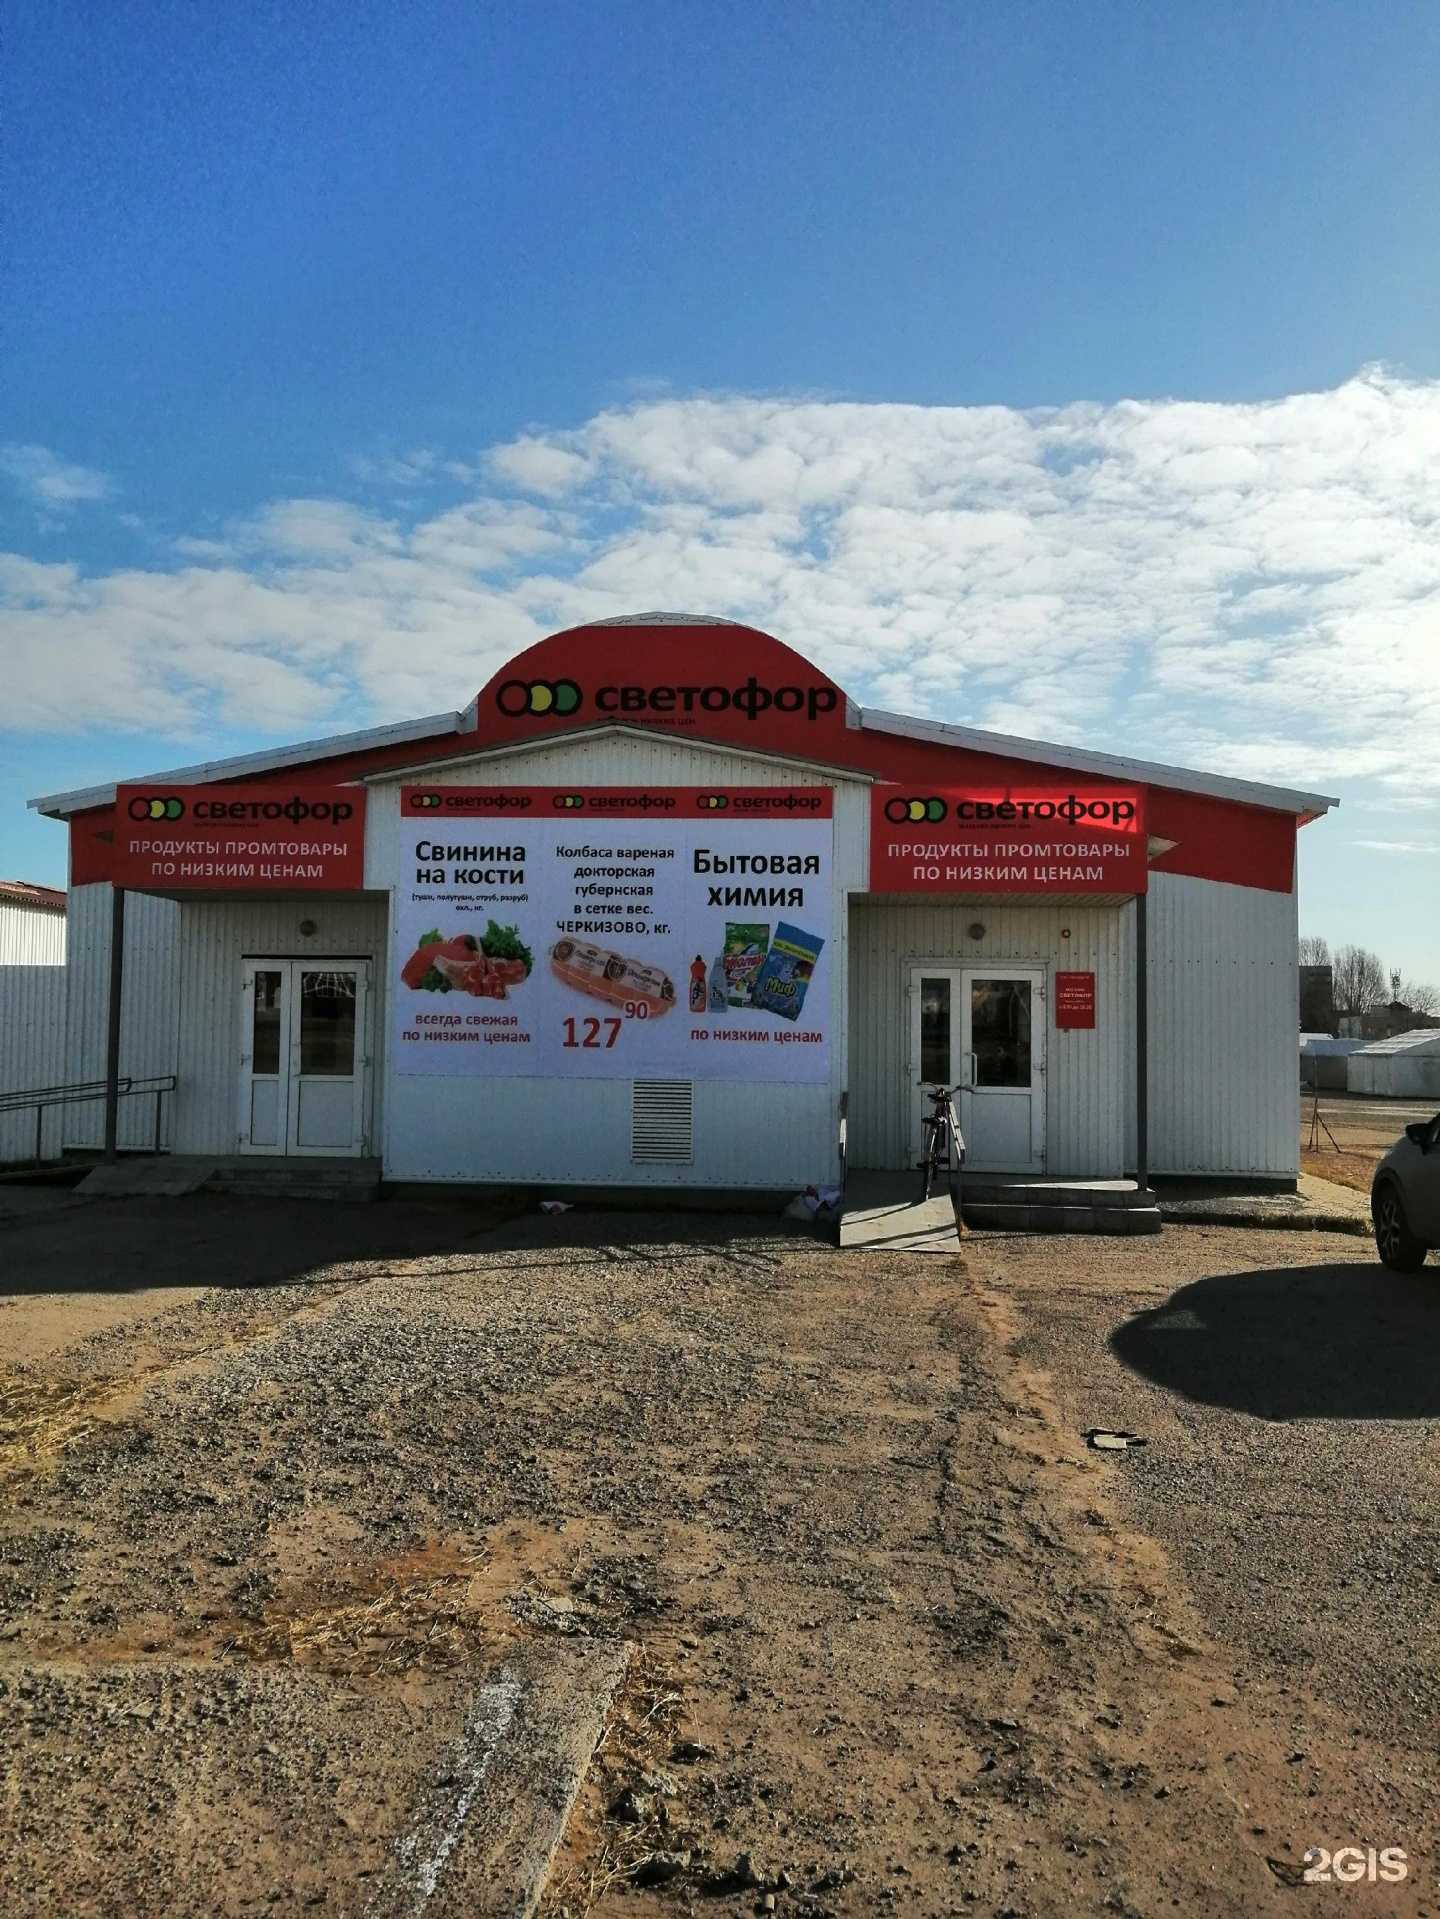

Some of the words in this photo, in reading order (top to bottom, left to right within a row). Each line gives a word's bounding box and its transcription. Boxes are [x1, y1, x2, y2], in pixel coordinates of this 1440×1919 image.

[595, 678, 837, 720] светофор
[446, 795, 533, 809] светофор
[588, 795, 676, 810] светофор
[733, 795, 822, 810] светофор
[956, 795, 1135, 825] светофор
[192, 796, 353, 825] светофор
[129, 840, 220, 856] ПРОДУКТЫ
[225, 842, 348, 857] ПРОМТОВАРЫ
[416, 840, 526, 861] Свинина
[556, 845, 613, 858] Колбаса
[616, 848, 675, 860] вареная
[887, 843, 989, 860] ПРОДУКТЫ
[994, 843, 1130, 857] ПРОМТОВАРЫ
[694, 849, 820, 875] Бытовая
[151, 863, 176, 876] ПО
[180, 863, 255, 877] НИЗКИМ
[259, 864, 324, 879] ЦЕНАМ
[416, 868, 446, 884] на
[454, 868, 524, 884] кости
[574, 867, 655, 879] докторская
[912, 866, 941, 880] ПО
[945, 866, 1028, 881] НИЗКИМ
[1033, 866, 1103, 882] ЦЕНАМ
[575, 883, 653, 897] губернская
[707, 887, 804, 907] химия
[574, 904, 582, 914] в
[585, 904, 623, 914] сетке
[626, 904, 653, 914] вес.
[556, 921, 650, 935] ЧЕРКИЗОВО,
[654, 925, 671, 934] кг.
[416, 1013, 462, 1027] всегда
[465, 1014, 518, 1026] свежая
[562, 1017, 622, 1048] 127
[625, 1001, 648, 1019] 90
[402, 1030, 420, 1041] по
[424, 1030, 480, 1042] низким
[483, 1032, 531, 1045] ценам
[691, 1029, 709, 1040] по
[713, 1030, 769, 1042] низким
[773, 1031, 823, 1045] ценам
